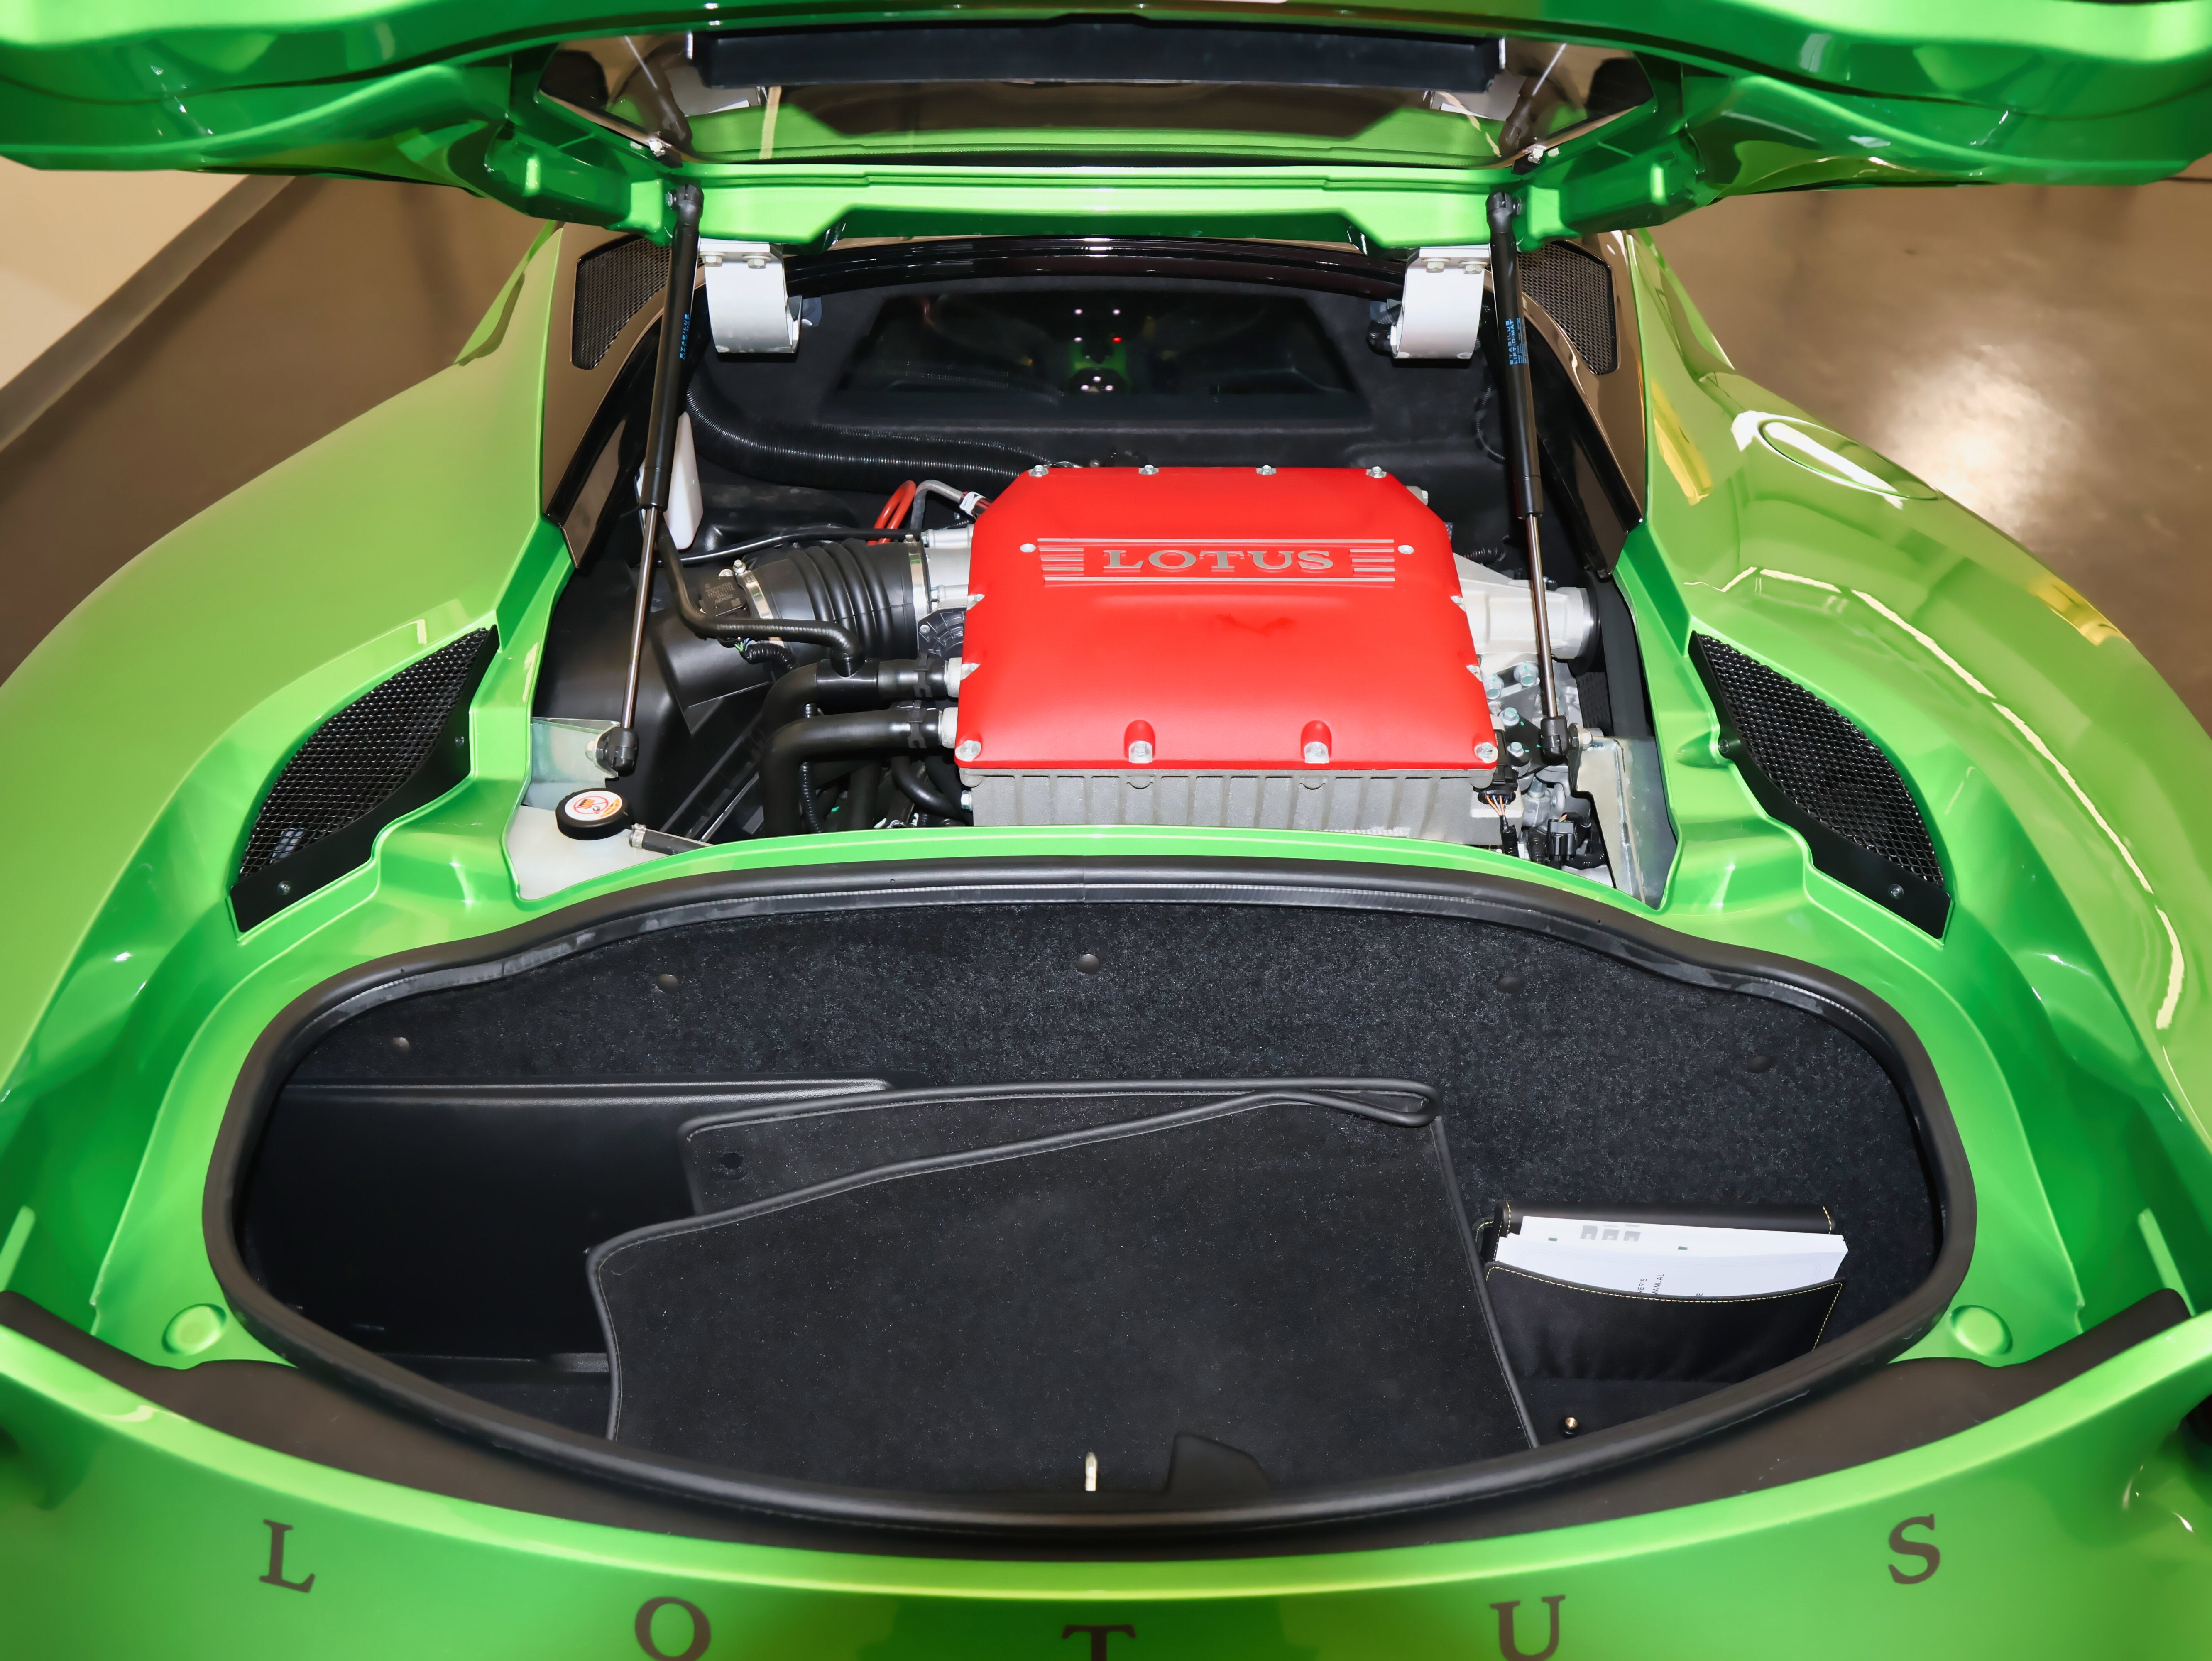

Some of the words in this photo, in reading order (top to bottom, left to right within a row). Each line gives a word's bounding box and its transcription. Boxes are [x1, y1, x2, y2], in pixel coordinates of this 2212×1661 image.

[1505, 320, 1514, 365] STABILUS
[1103, 549, 1334, 571] LOTUS
[705, 581, 733, 593] TOYOTA
[714, 594, 733, 604] DENSO
